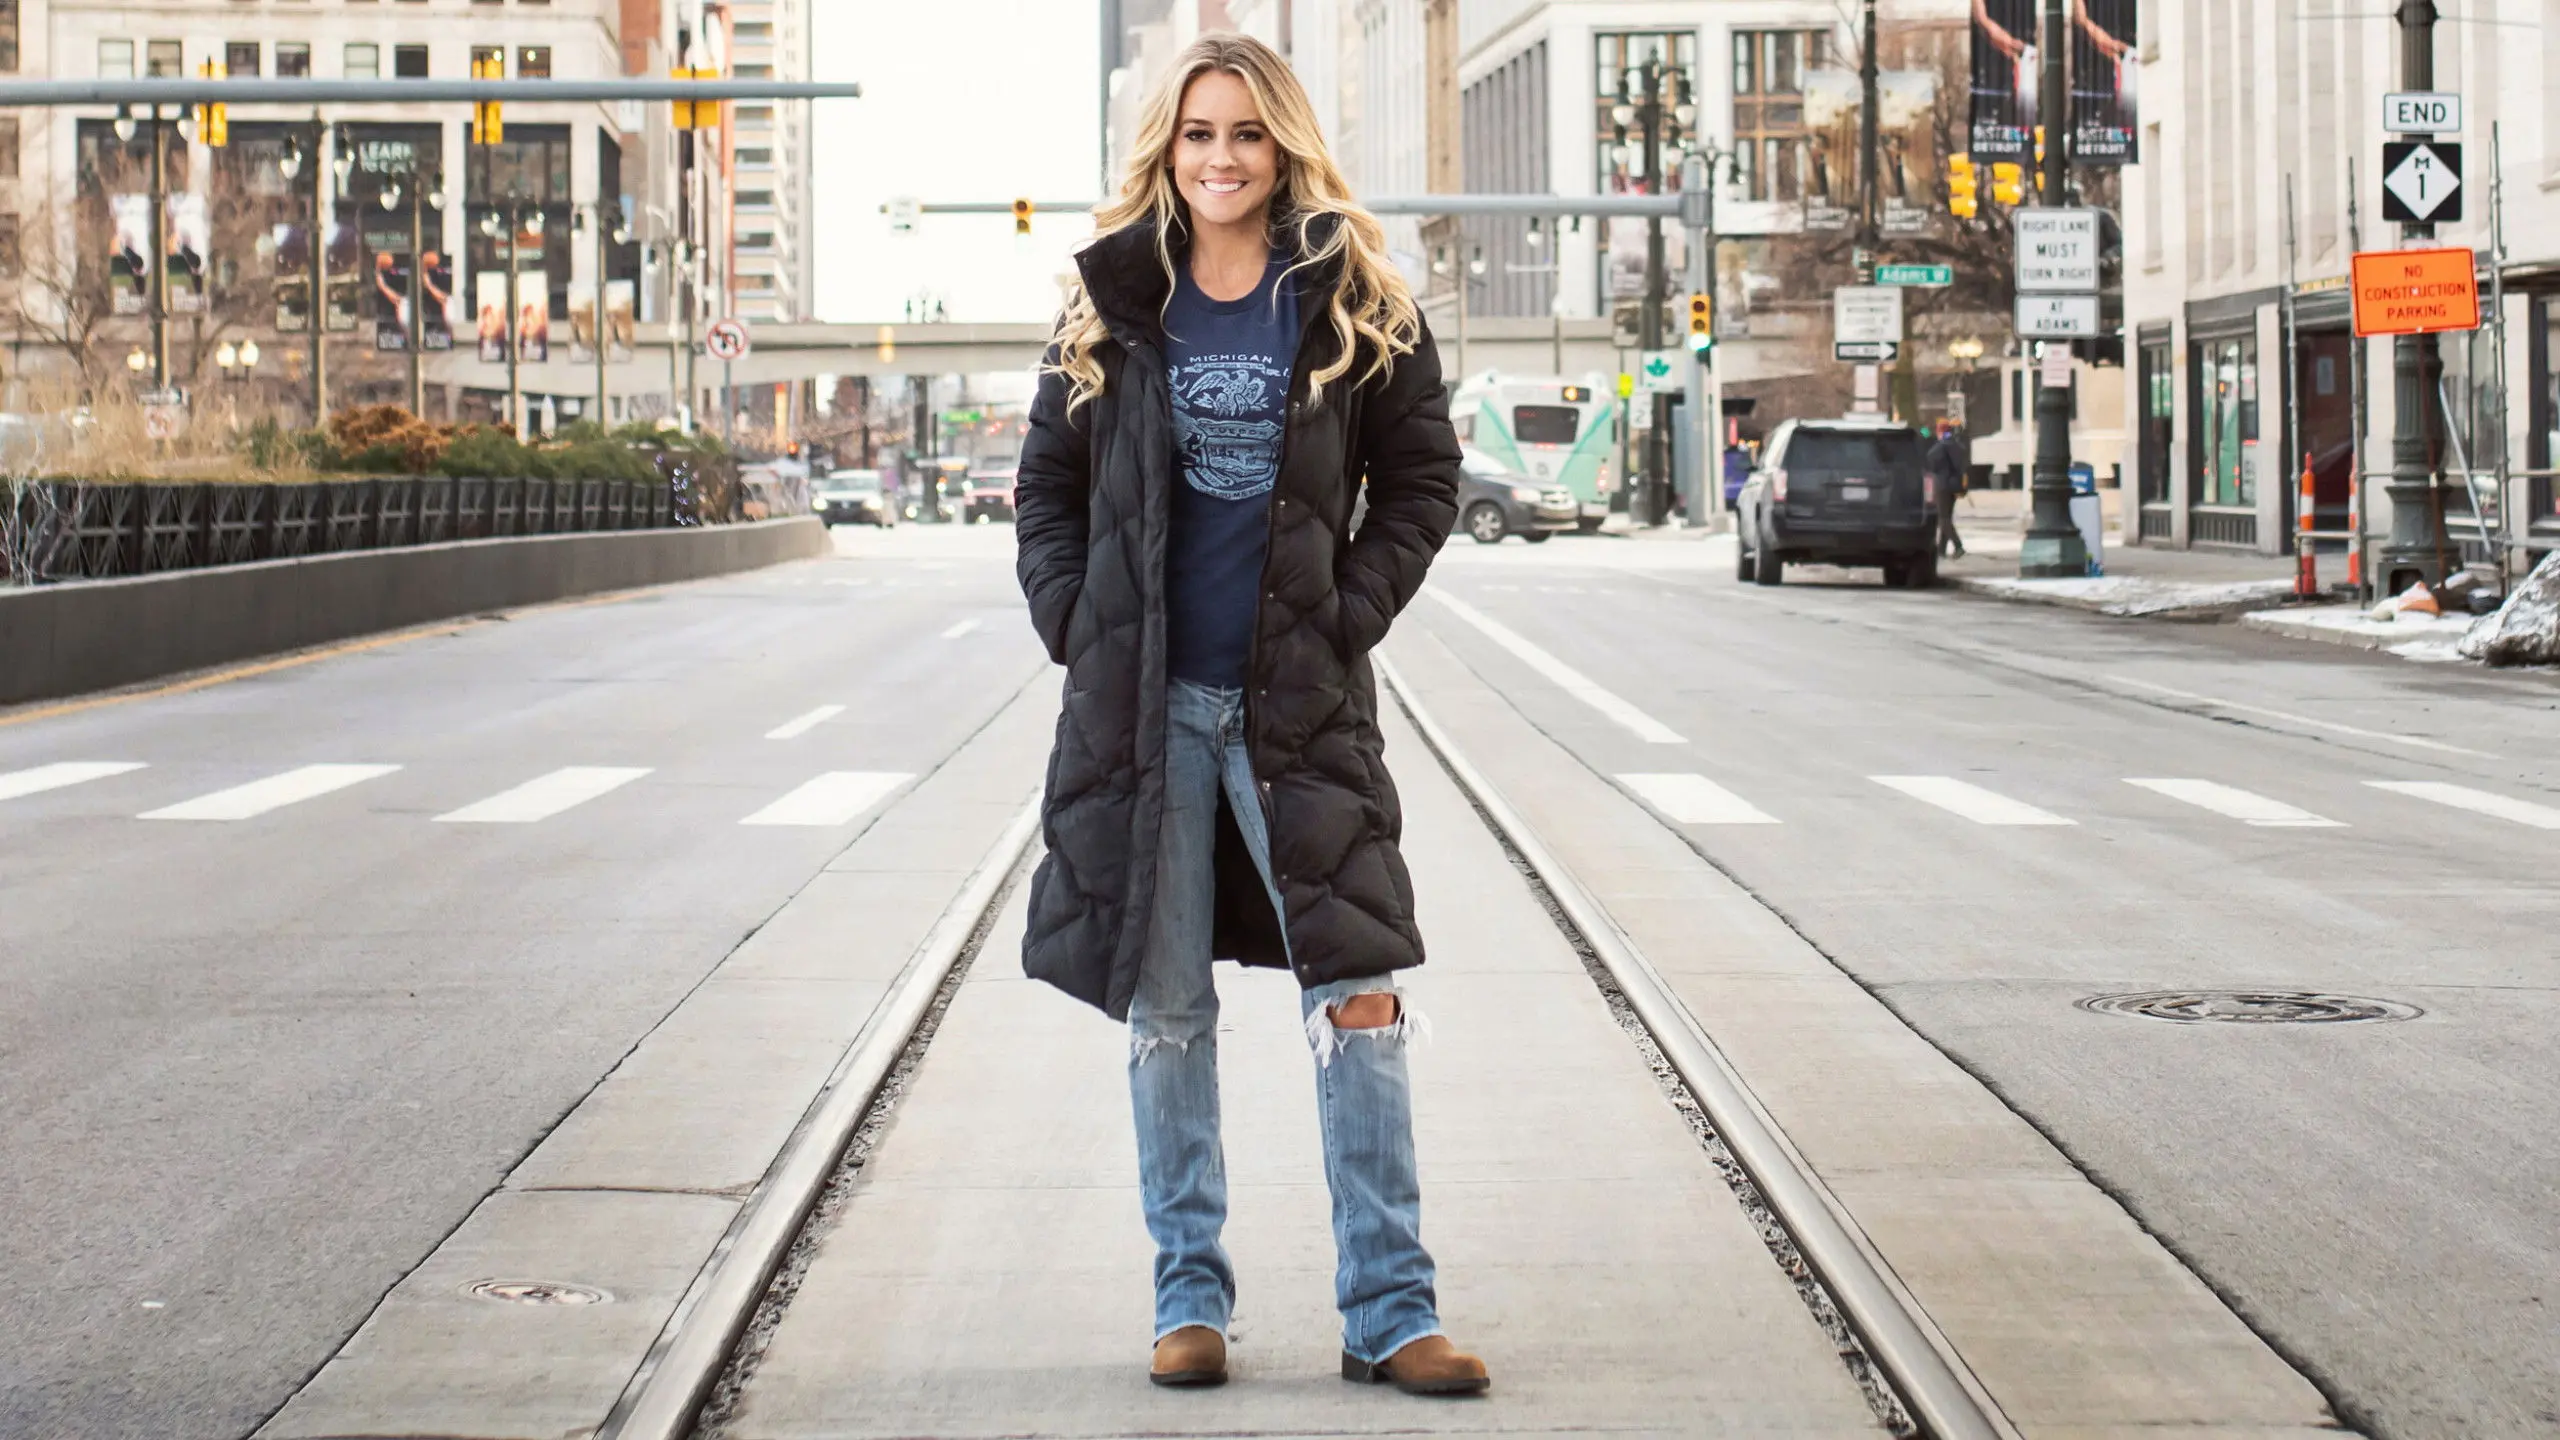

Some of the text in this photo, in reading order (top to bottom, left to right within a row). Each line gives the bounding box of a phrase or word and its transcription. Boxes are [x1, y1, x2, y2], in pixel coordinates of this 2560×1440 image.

[2398, 102, 2446, 124] END
[2415, 157, 2430, 169] M
[2419, 174, 2425, 200] 1
[2022, 220, 2090, 233] RIGHT LANE
[2036, 243, 2079, 258] MUST
[2022, 268, 2092, 281] TURN RIGHT
[2404, 265, 2423, 278] NO
[2365, 283, 2467, 301] CONSTRUCTION
[2050, 301, 2064, 314] AT
[2386, 304, 2447, 320] PARKING
[2035, 319, 2078, 332] ADAMS
[1189, 354, 1273, 363] MICHIGAN
